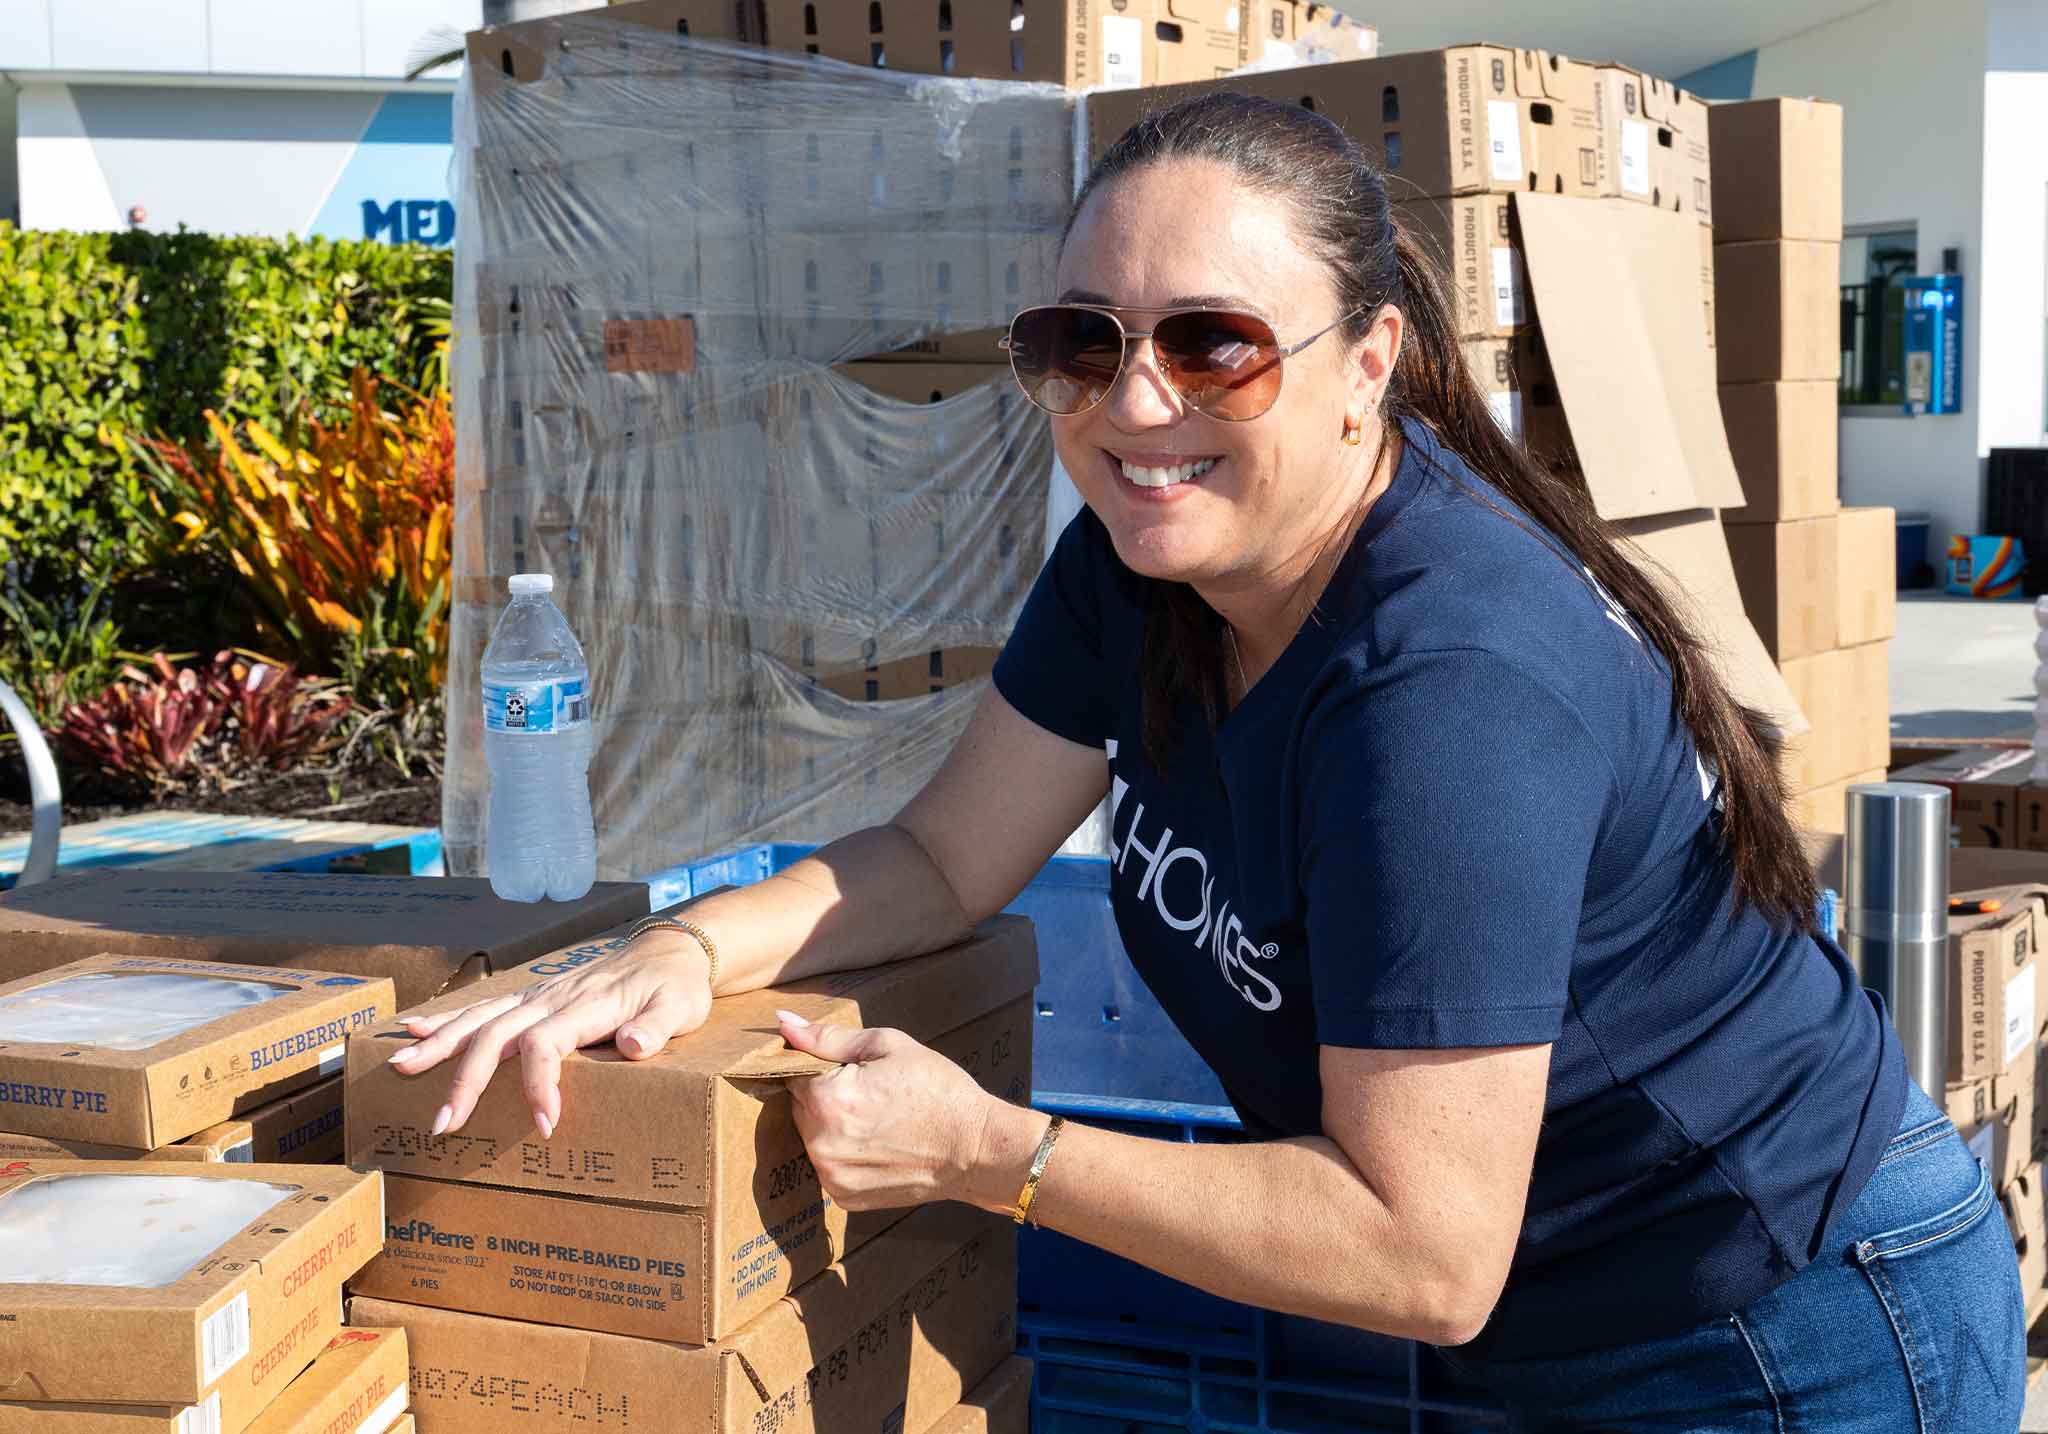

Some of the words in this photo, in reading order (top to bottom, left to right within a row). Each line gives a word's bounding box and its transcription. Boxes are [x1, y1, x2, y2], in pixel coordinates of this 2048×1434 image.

[1458, 57, 1471, 117] PRODUCT
[1460, 118, 1472, 134] OF
[1464, 207, 1477, 263] PRODUCT
[1465, 265, 1478, 281] OF
[1971, 950, 1985, 1006] PRODUCT
[1972, 1010, 1985, 1025] OF
[250, 1017, 348, 1072] BLUEBERRY
[72, 1089, 108, 1114] PIE
[521, 1142, 616, 1184] BLUE
[282, 1239, 335, 1299] CHERRY
[336, 1221, 358, 1255] PIE
[486, 1235, 498, 1250] 8
[501, 1237, 541, 1258] INCH
[545, 1243, 641, 1273] PRE-BAKED
[645, 1258, 687, 1279] PIES
[737, 1240, 754, 1262] KEEP
[420, 1278, 440, 1290] PIES
[513, 1265, 544, 1280] STORE
[546, 1270, 557, 1281] AT
[610, 1280, 625, 1293] OR
[627, 1282, 663, 1298] BELOW
[736, 1278, 756, 1301] WITH
[756, 1265, 778, 1288] KNIFE
[737, 1266, 749, 1283] DO
[750, 1256, 767, 1275] NOT
[509, 1278, 526, 1290] DO
[527, 1280, 549, 1294] NOT
[550, 1284, 577, 1298] DROP
[578, 1288, 593, 1301] OR
[595, 1291, 625, 1306] STACK
[626, 1295, 644, 1309] ON
[645, 1299, 668, 1312] SIDE
[251, 1325, 299, 1387] CHERRY
[299, 1306, 321, 1340] PIE
[366, 1374, 386, 1410] PIE
